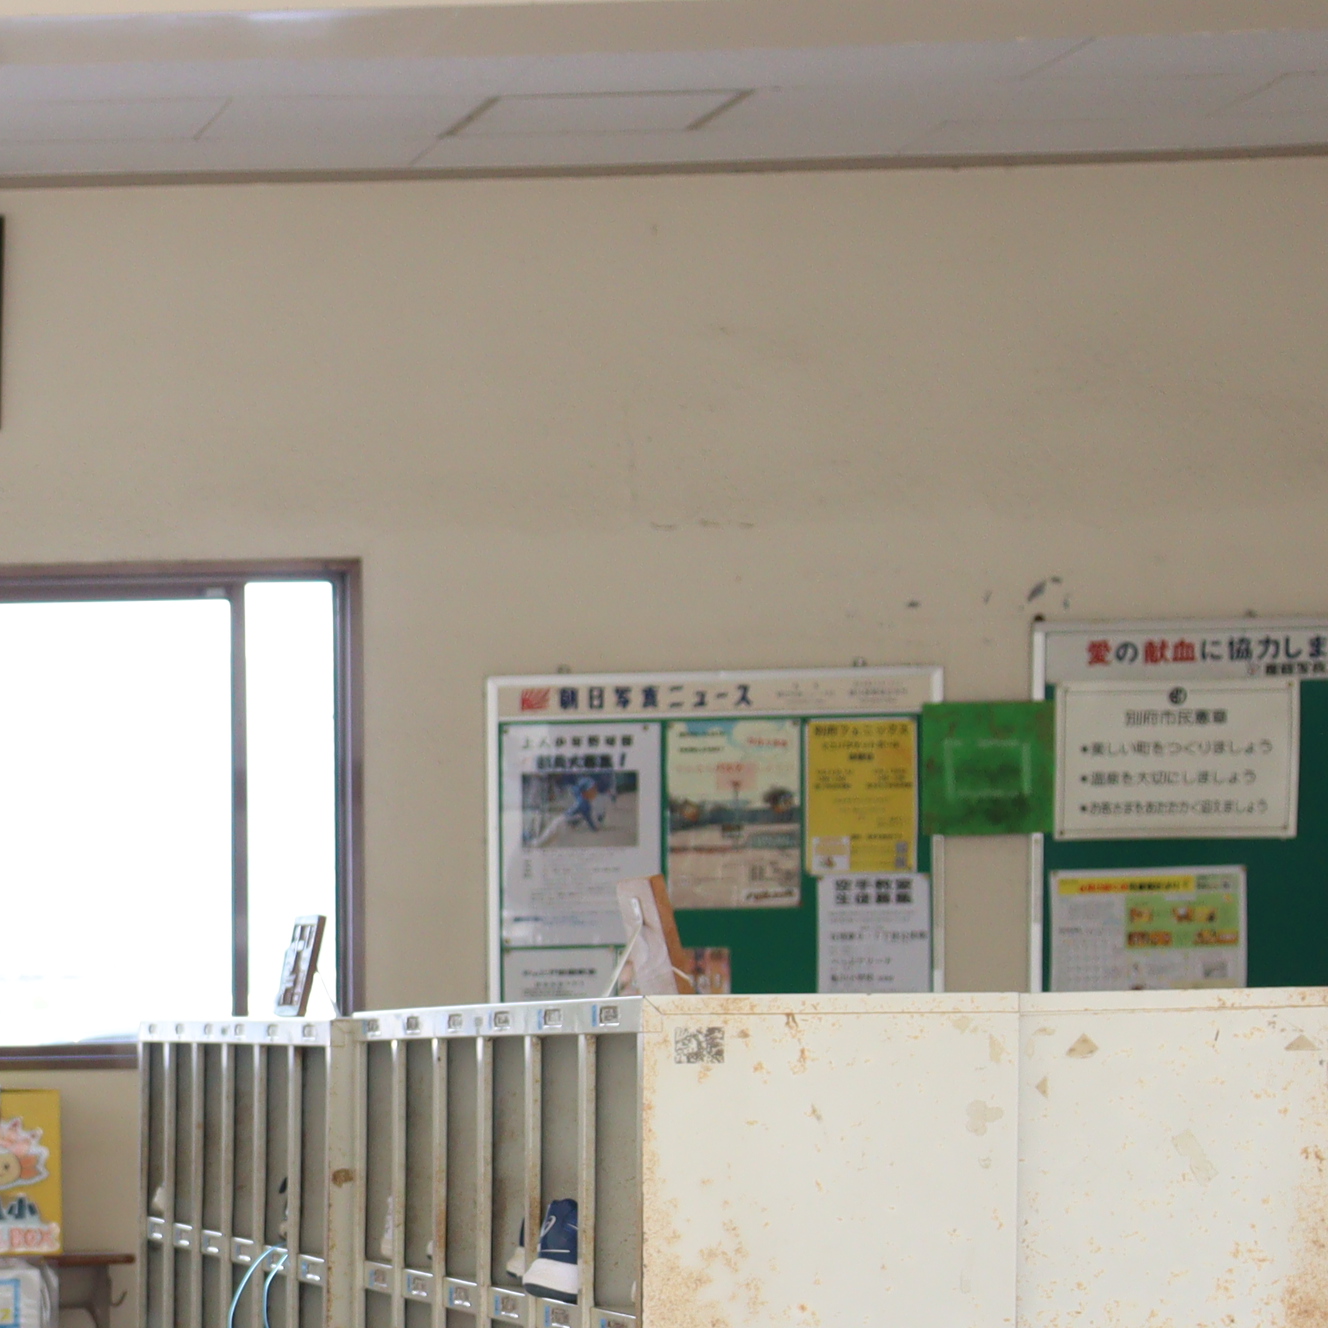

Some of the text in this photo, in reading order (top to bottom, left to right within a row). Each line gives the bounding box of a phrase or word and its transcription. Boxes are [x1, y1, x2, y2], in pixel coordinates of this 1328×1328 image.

[559, 684, 753, 709] 朝日写真ニュース
[1125, 708, 1228, 726] 別府市民憲章
